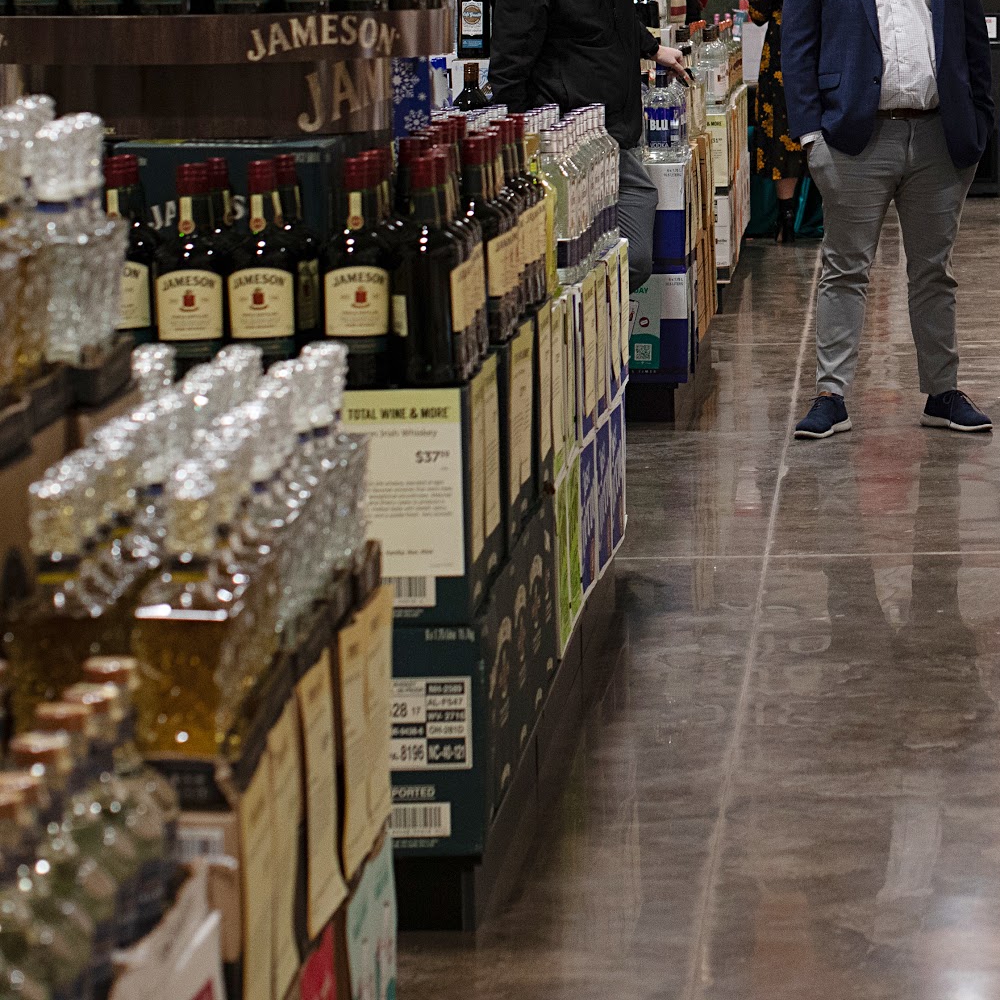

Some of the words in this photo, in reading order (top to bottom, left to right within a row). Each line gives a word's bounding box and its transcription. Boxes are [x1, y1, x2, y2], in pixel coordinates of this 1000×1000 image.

[246, 14, 396, 62] JAMESON
[649, 119, 669, 131] BLU
[348, 408, 377, 421] TOTAL
[380, 407, 406, 420] WINE
[410, 407, 418, 419] &
[421, 406, 449, 419] MORE
